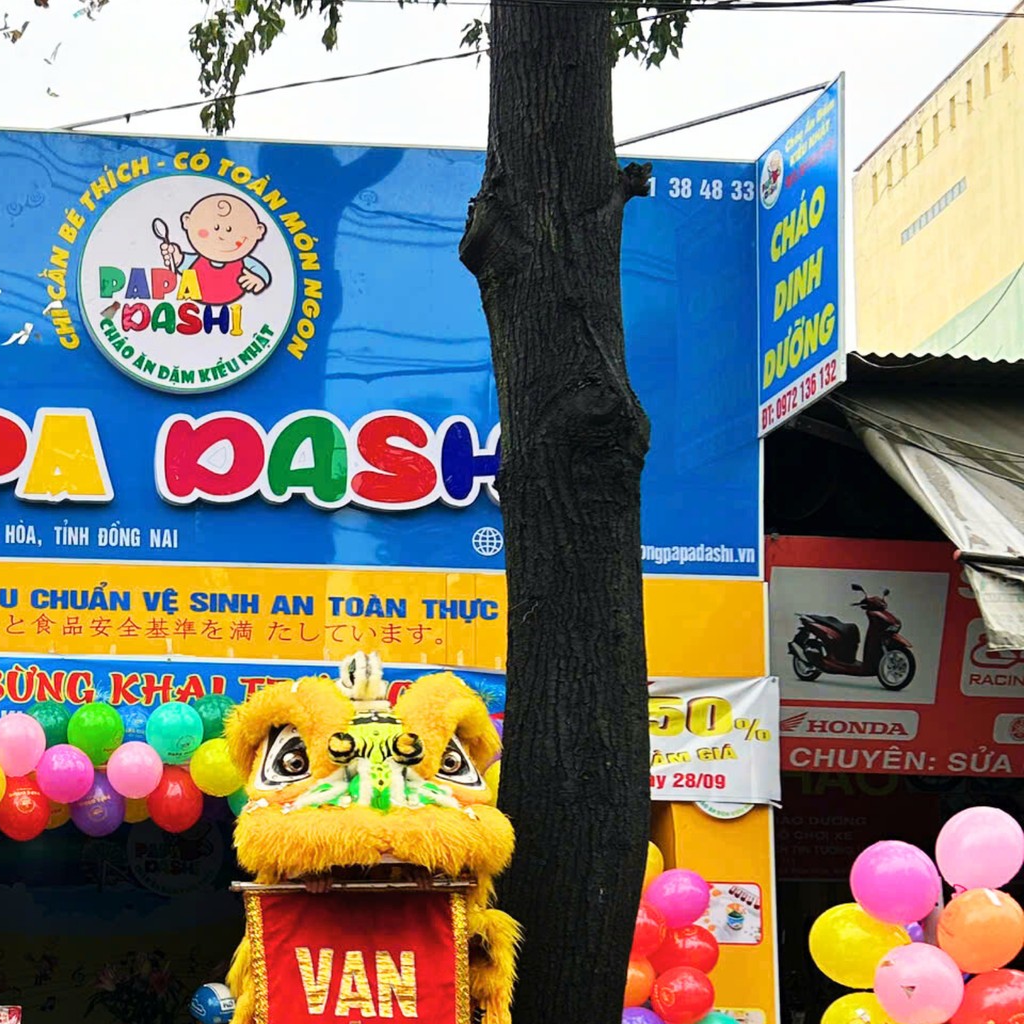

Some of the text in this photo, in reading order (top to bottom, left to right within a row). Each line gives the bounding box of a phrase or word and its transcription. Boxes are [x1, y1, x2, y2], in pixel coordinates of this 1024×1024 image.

[173, 148, 210, 171] CÓ
[79, 156, 150, 212] THÍCH
[216, 159, 287, 211] TOÀN
[669, 177, 692, 198] 38
[700, 179, 723, 200] 48
[731, 180, 755, 201] 33
[58, 209, 86, 244] BÉ
[280, 211, 320, 271] MÓN
[770, 186, 826, 263] CHÁO
[99, 266, 202, 300] PAPA
[773, 246, 824, 322] DINH
[121, 302, 243, 336] DASHI
[287, 278, 323, 360] NGON
[100, 318, 133, 360] CHÁO
[133, 353, 155, 375] ĂN
[198, 357, 238, 383] KIỂU
[235, 324, 275, 366] NHẬT
[763, 303, 836, 390] DƯỠNG
[776, 388, 797, 419] 0972
[800, 373, 817, 404] 136
[820, 359, 837, 390] 132
[156, 409, 506, 510] DASH
[5, 519, 42, 547] HÒA,
[54, 517, 90, 547] TỈNH
[97, 516, 142, 548] ĐỒNG
[150, 528, 178, 549] NAI
[641, 544, 755, 564] ngpapadashi.vn
[30, 582, 131, 612] CHUẨN
[142, 588, 178, 615] VỆ
[189, 593, 259, 614] SINH
[270, 595, 314, 616] AN
[328, 592, 407, 620] TOÀN
[422, 598, 499, 623] THỰC
[110, 671, 227, 706] KHAI
[969, 674, 1024, 687] RACIN
[648, 695, 772, 743] 50%
[806, 720, 909, 736] HONDA
[696, 743, 739, 761] GIÁ
[789, 745, 1012, 773] CHUYÊN: SỬA
[673, 773, 726, 789] 28/09
